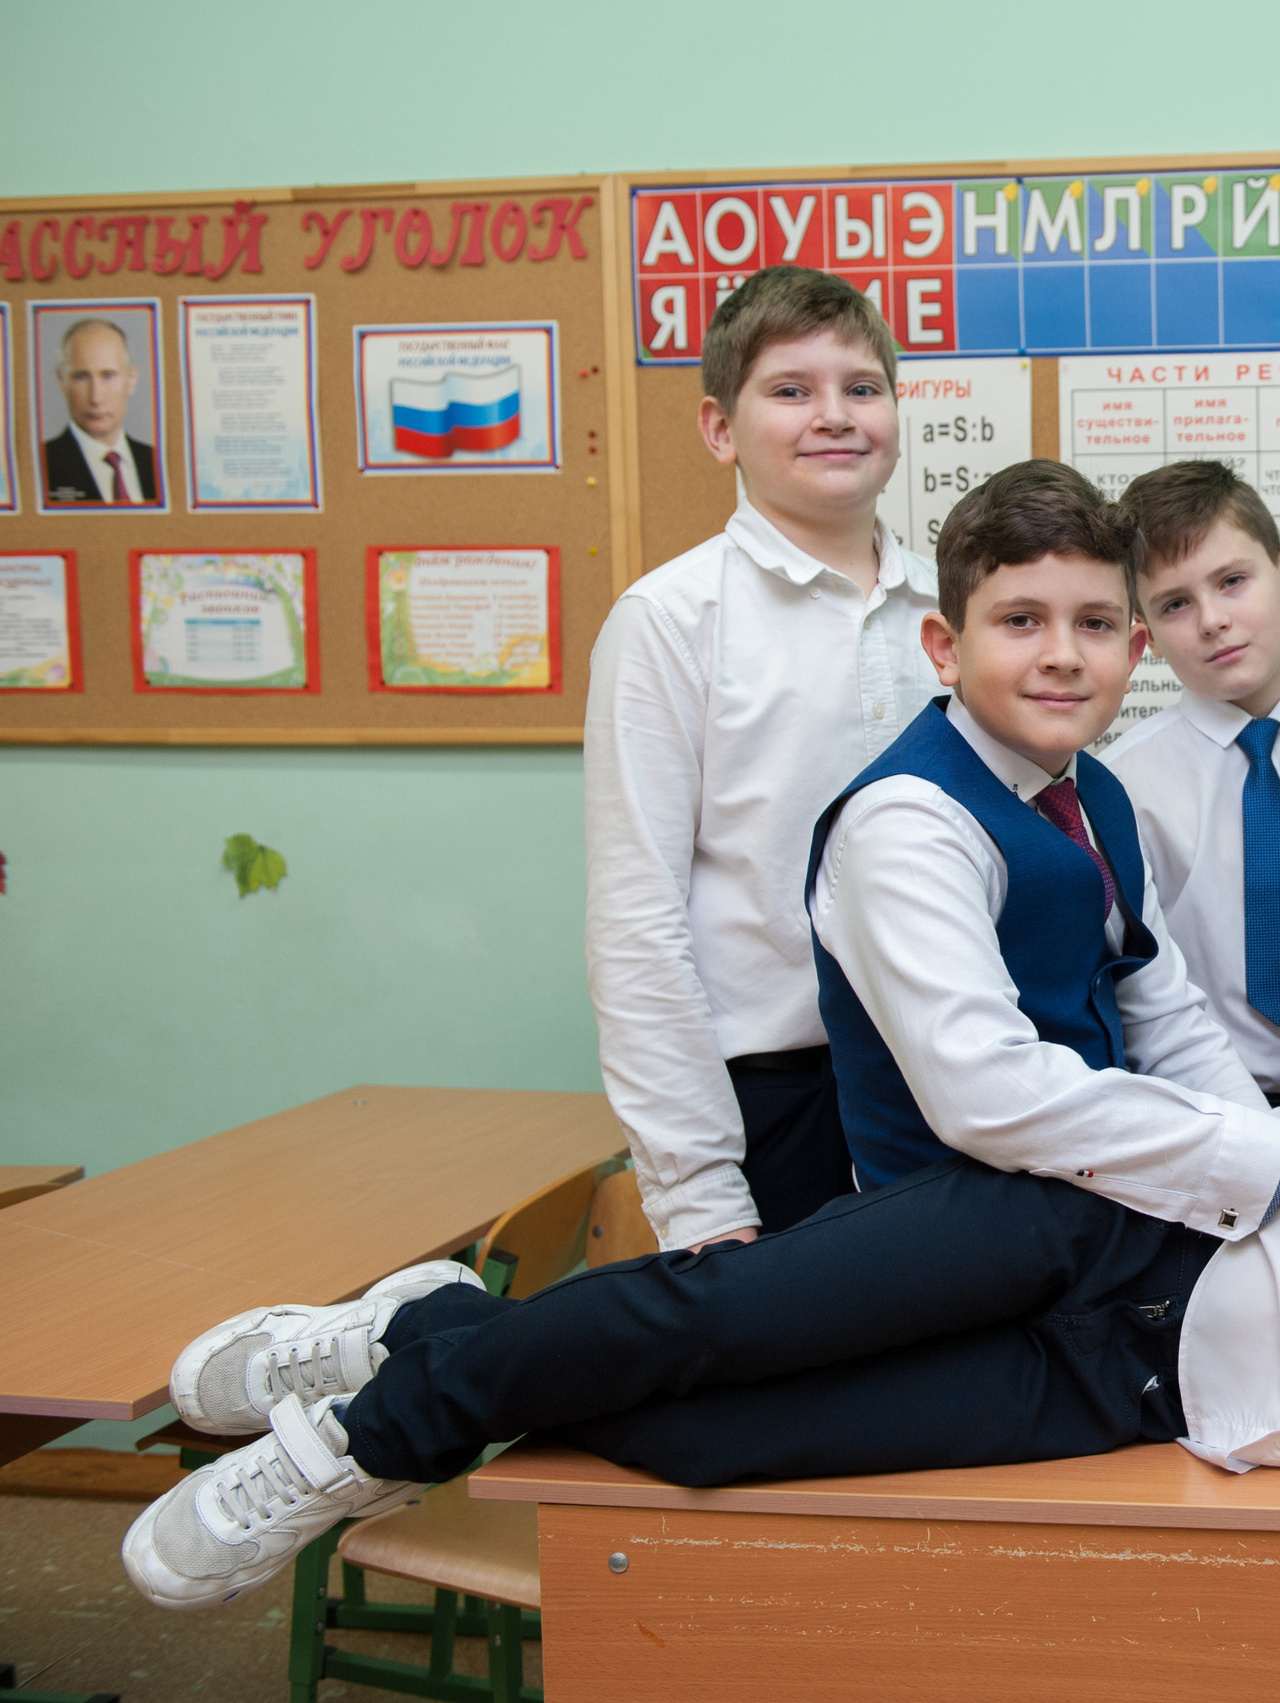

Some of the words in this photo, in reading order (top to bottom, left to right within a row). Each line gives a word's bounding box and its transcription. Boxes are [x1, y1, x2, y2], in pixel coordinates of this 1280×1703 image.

[301, 196, 595, 272] УГОЛОК
[641, 201, 695, 266] А
[703, 197, 758, 265] О
[768, 195, 817, 262] У
[834, 193, 887, 260] Ы
[902, 191, 946, 259] Э
[649, 285, 688, 349] Я
[906, 278, 944, 344] Е
[1107, 365, 1210, 383] ЧАСТИ
[1102, 401, 1133, 412] имя
[1194, 398, 1228, 409] имя
[1077, 416, 1159, 431] существи-
[1173, 414, 1249, 428] прилага-
[1085, 433, 1151, 445] тельное
[1176, 431, 1247, 443] тельное
[923, 466, 995, 493] b=S:
